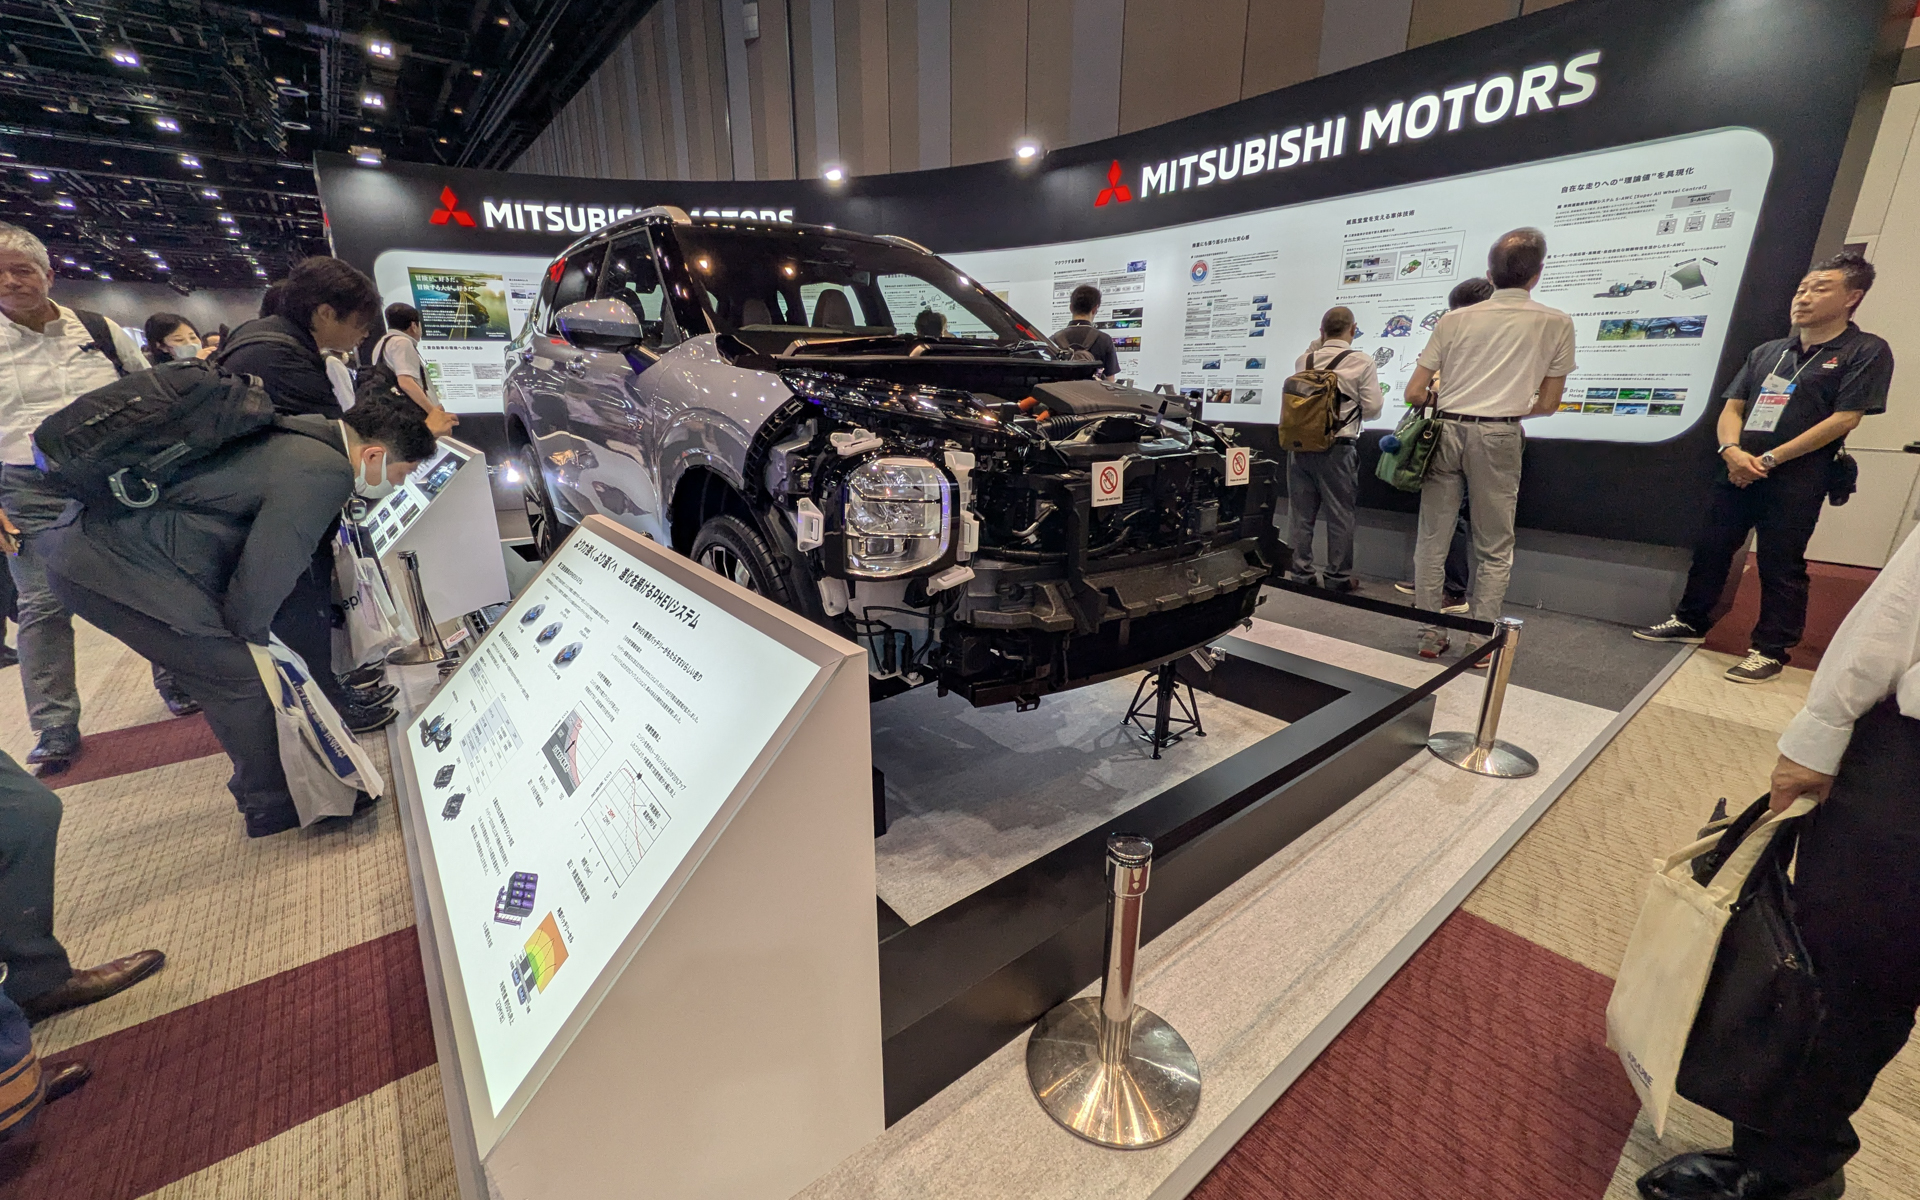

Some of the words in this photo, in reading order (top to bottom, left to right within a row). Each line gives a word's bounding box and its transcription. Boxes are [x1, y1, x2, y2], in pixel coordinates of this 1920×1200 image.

[1140, 117, 1347, 198] MITSUBISHI
[1359, 51, 1600, 151] MOTORS
[1561, 167, 1695, 194] 自在な走りへの“理論値”を具現化
[483, 201, 643, 233] MITSUBI
[573, 537, 618, 574] より力強く、より遠くへ
[618, 567, 702, 630] 進化を続けるPHEVシステム
[635, 624, 703, 683] PHEV専用バッテリーがもたらすEVらしい走り
[555, 905, 575, 945] 角型バッテリーセル
